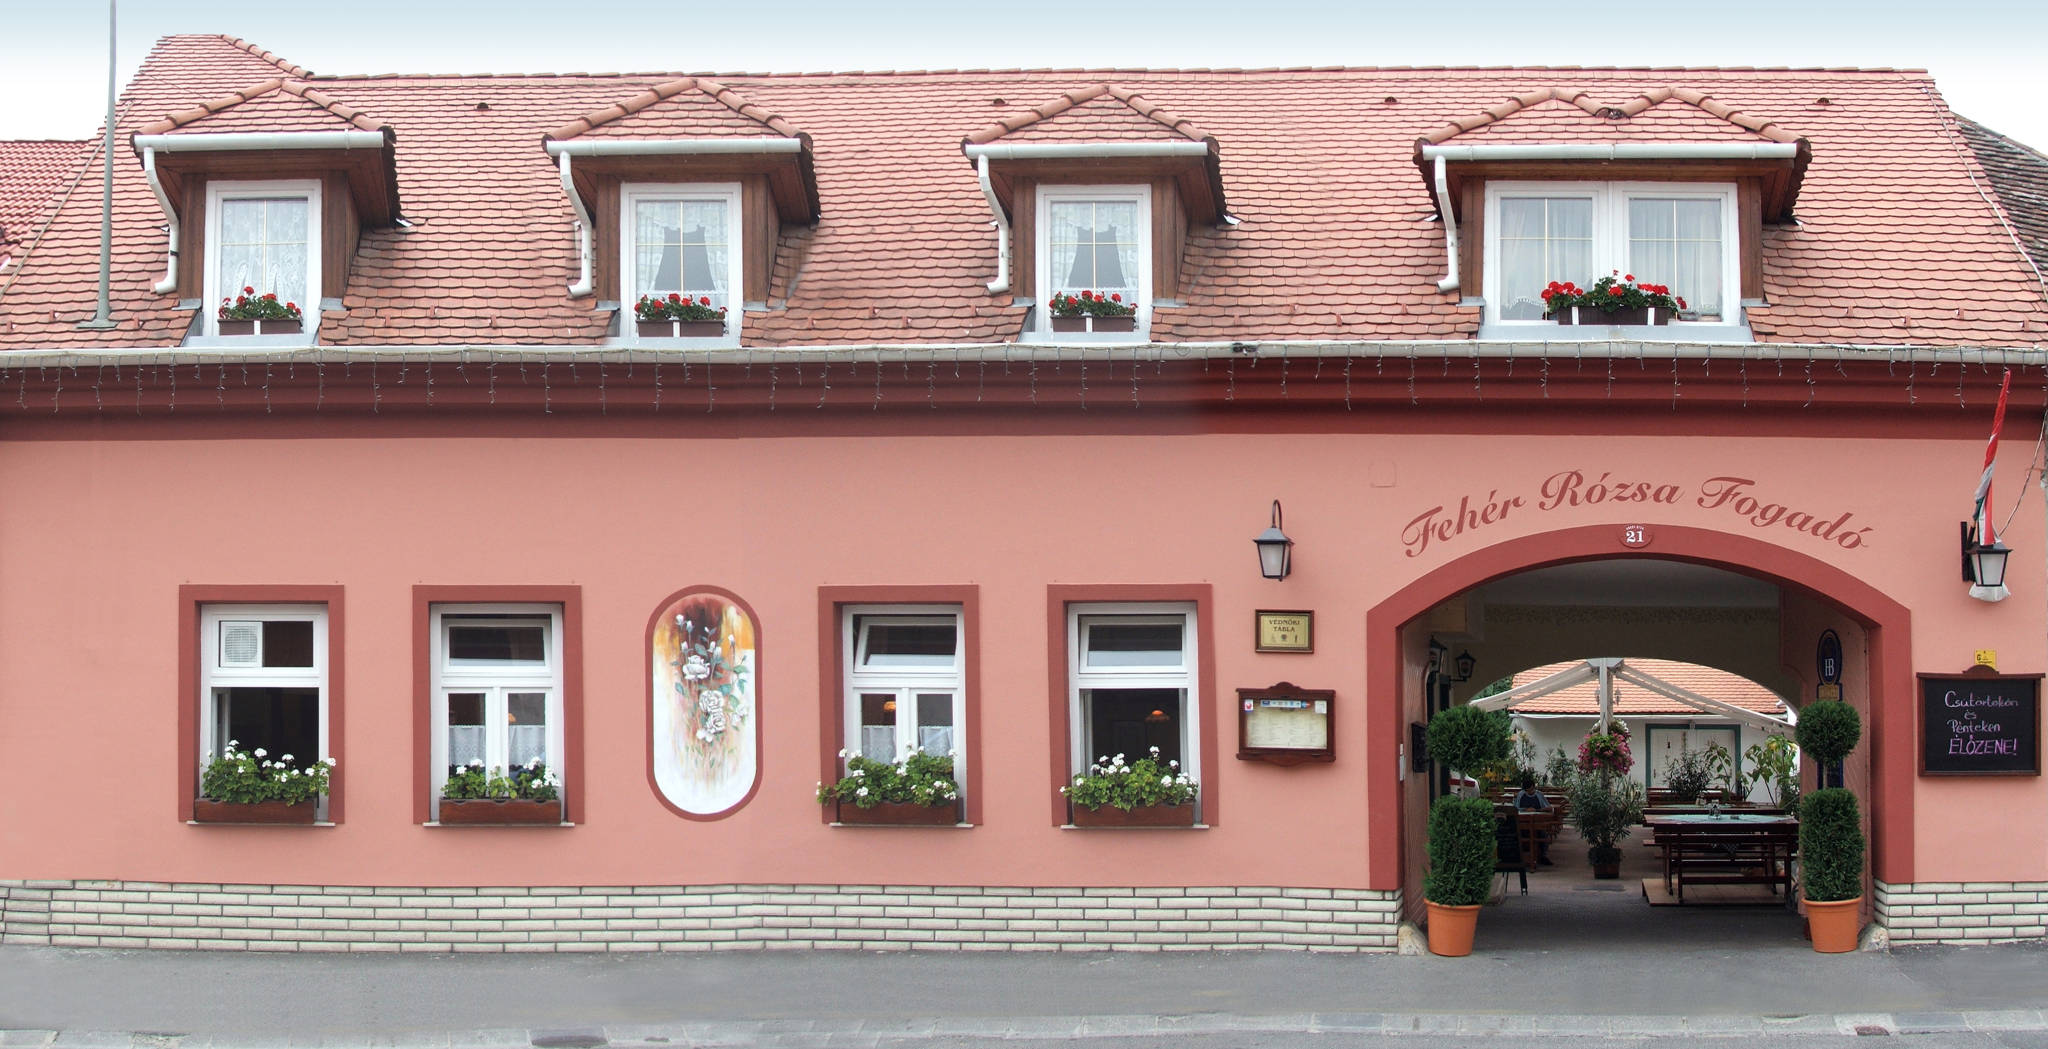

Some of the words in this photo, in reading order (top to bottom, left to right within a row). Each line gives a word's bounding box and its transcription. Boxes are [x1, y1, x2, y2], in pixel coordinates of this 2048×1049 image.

[1401, 489, 1527, 558] Fehér
[1538, 469, 1685, 511] Rózsa
[1697, 476, 1873, 549] Fogadó
[1626, 530, 1644, 543] 21
[1824, 658, 1835, 677] HB
[1964, 709, 1977, 719] és
[1947, 719, 2001, 733] Pénteken
